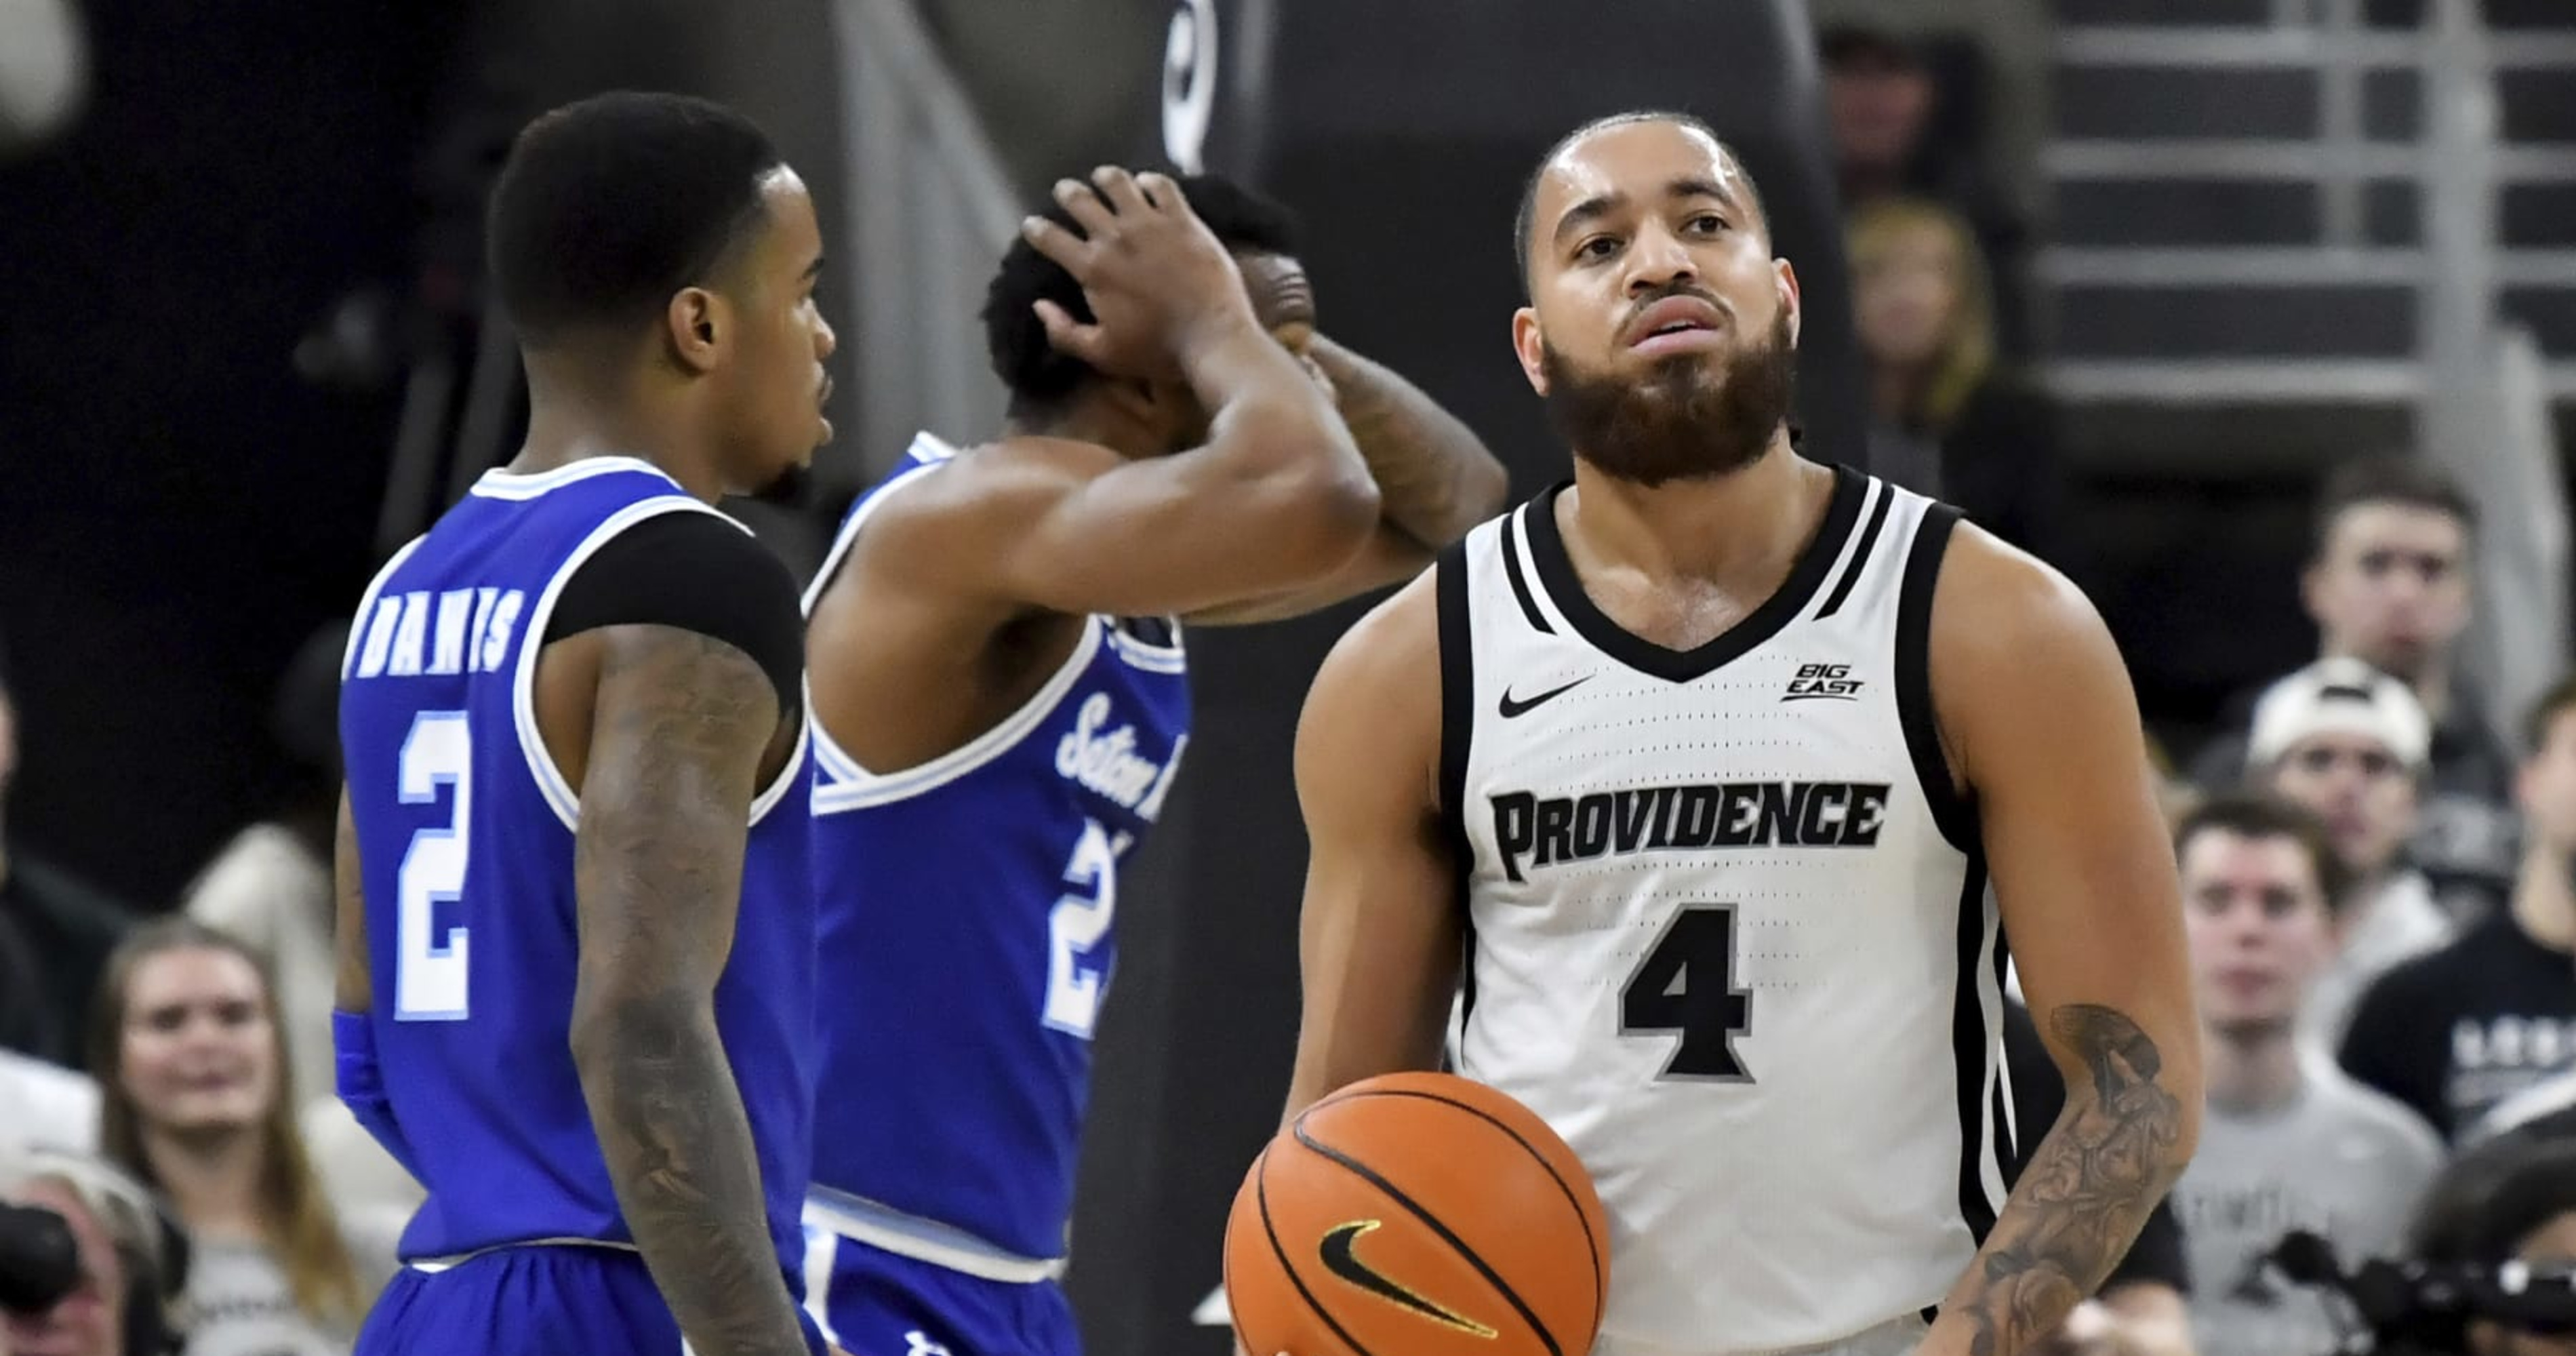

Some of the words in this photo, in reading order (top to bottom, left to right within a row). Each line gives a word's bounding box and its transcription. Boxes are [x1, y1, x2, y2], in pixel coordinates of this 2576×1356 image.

[1786, 680, 1865, 694] EAST
[1796, 664, 1851, 679] BIG
[394, 710, 471, 1021] 2
[1486, 780, 1893, 884] PROVIDENCE
[1041, 817, 1134, 1040] 2
[1617, 902, 1756, 1085] 4
